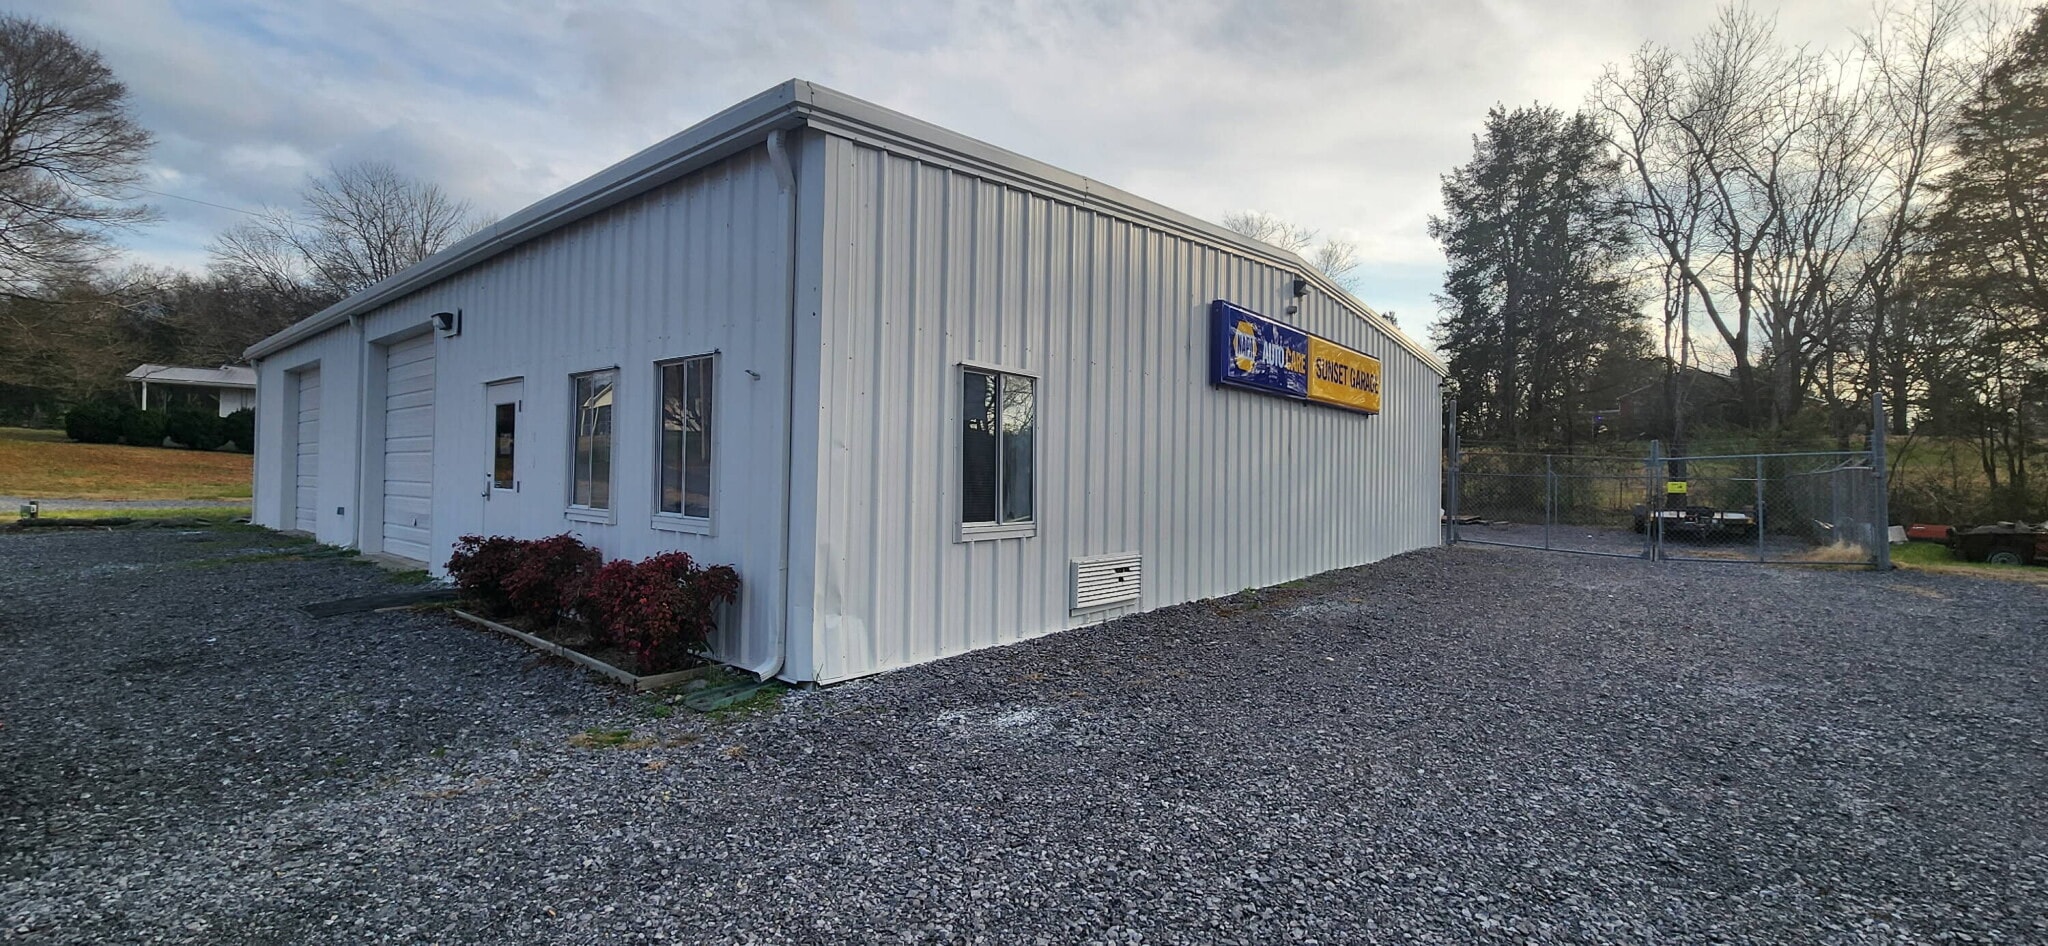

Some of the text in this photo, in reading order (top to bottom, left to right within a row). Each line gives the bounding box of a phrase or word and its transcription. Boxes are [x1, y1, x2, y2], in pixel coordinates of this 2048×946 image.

[1262, 341, 1306, 374] AUTO CARE
[1316, 358, 1379, 394] SUNSET GARAGE
